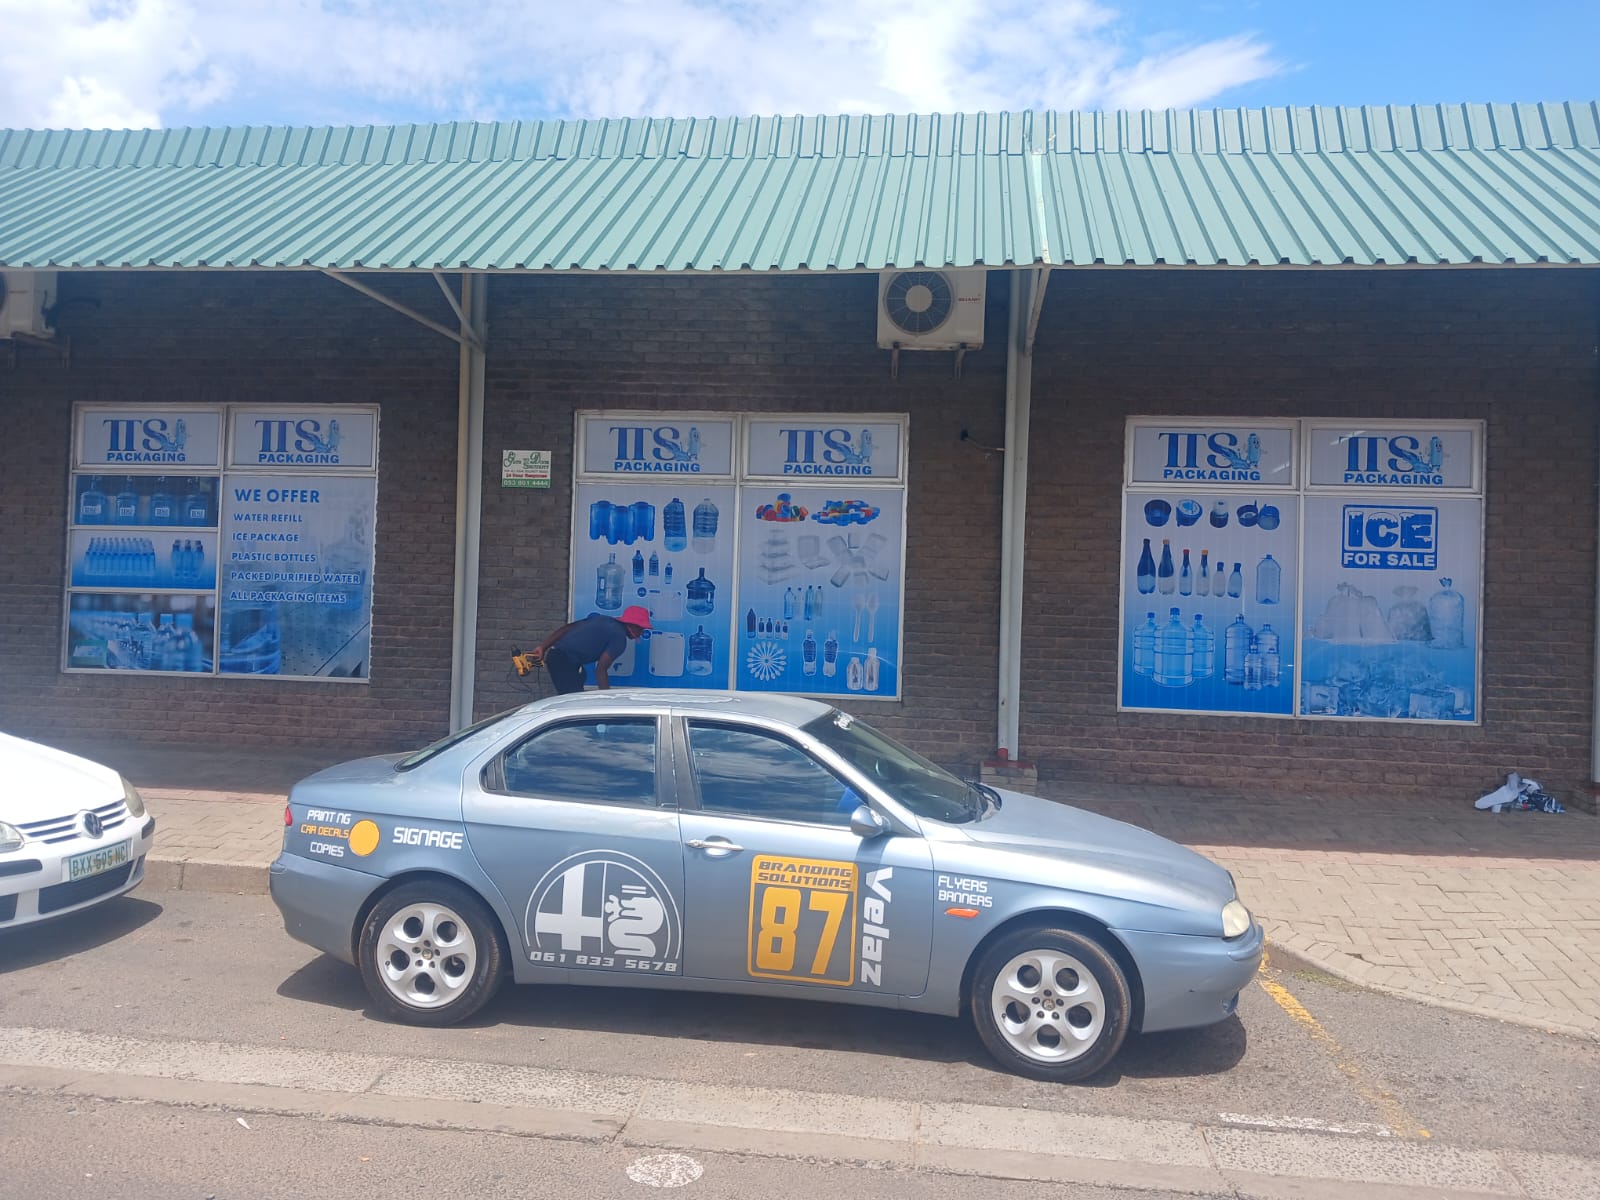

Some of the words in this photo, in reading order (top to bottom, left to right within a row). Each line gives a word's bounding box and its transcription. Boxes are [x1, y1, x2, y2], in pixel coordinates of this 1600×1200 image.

[106, 452, 186, 463] PACKAGING
[258, 453, 340, 464] PACKAGING
[613, 461, 700, 472] PACKAGING
[783, 464, 872, 475] PACKAGING
[1163, 469, 1261, 481] PACKAGING
[1343, 473, 1443, 485] PACKAGING
[235, 489, 261, 502] WE
[266, 489, 320, 503] OFFER
[233, 513, 269, 522] WATER
[271, 514, 303, 522] REFILL
[1347, 510, 1433, 548] ICE
[232, 533, 248, 541] ICE
[250, 533, 300, 542] PACKAGE
[231, 552, 272, 561] PLASTIC
[274, 553, 316, 562] BOTTLES
[1343, 552, 1382, 567] FOR
[1386, 553, 1437, 569] SALE
[231, 572, 272, 581] PACKED
[274, 573, 321, 582] PURIFIED
[323, 574, 361, 583] WATER
[230, 591, 248, 601] ALL
[250, 592, 314, 602] PACKAGING
[316, 593, 346, 602] ITEMS
[301, 824, 317, 834] CAR
[318, 826, 350, 838] DECALS
[392, 826, 464, 849] SIGNAGE
[115, 846, 126, 864] NC
[310, 841, 344, 857] COPIES
[758, 861, 853, 877] BRANDING
[758, 872, 852, 889] SOLUTIONS
[937, 876, 989, 893] FLYERS
[938, 890, 993, 908] BANNERS
[756, 887, 848, 975] 87
[861, 867, 893, 987] Velaz
[530, 951, 566, 962] 061
[576, 955, 615, 966] 833
[625, 959, 678, 972] 5678
